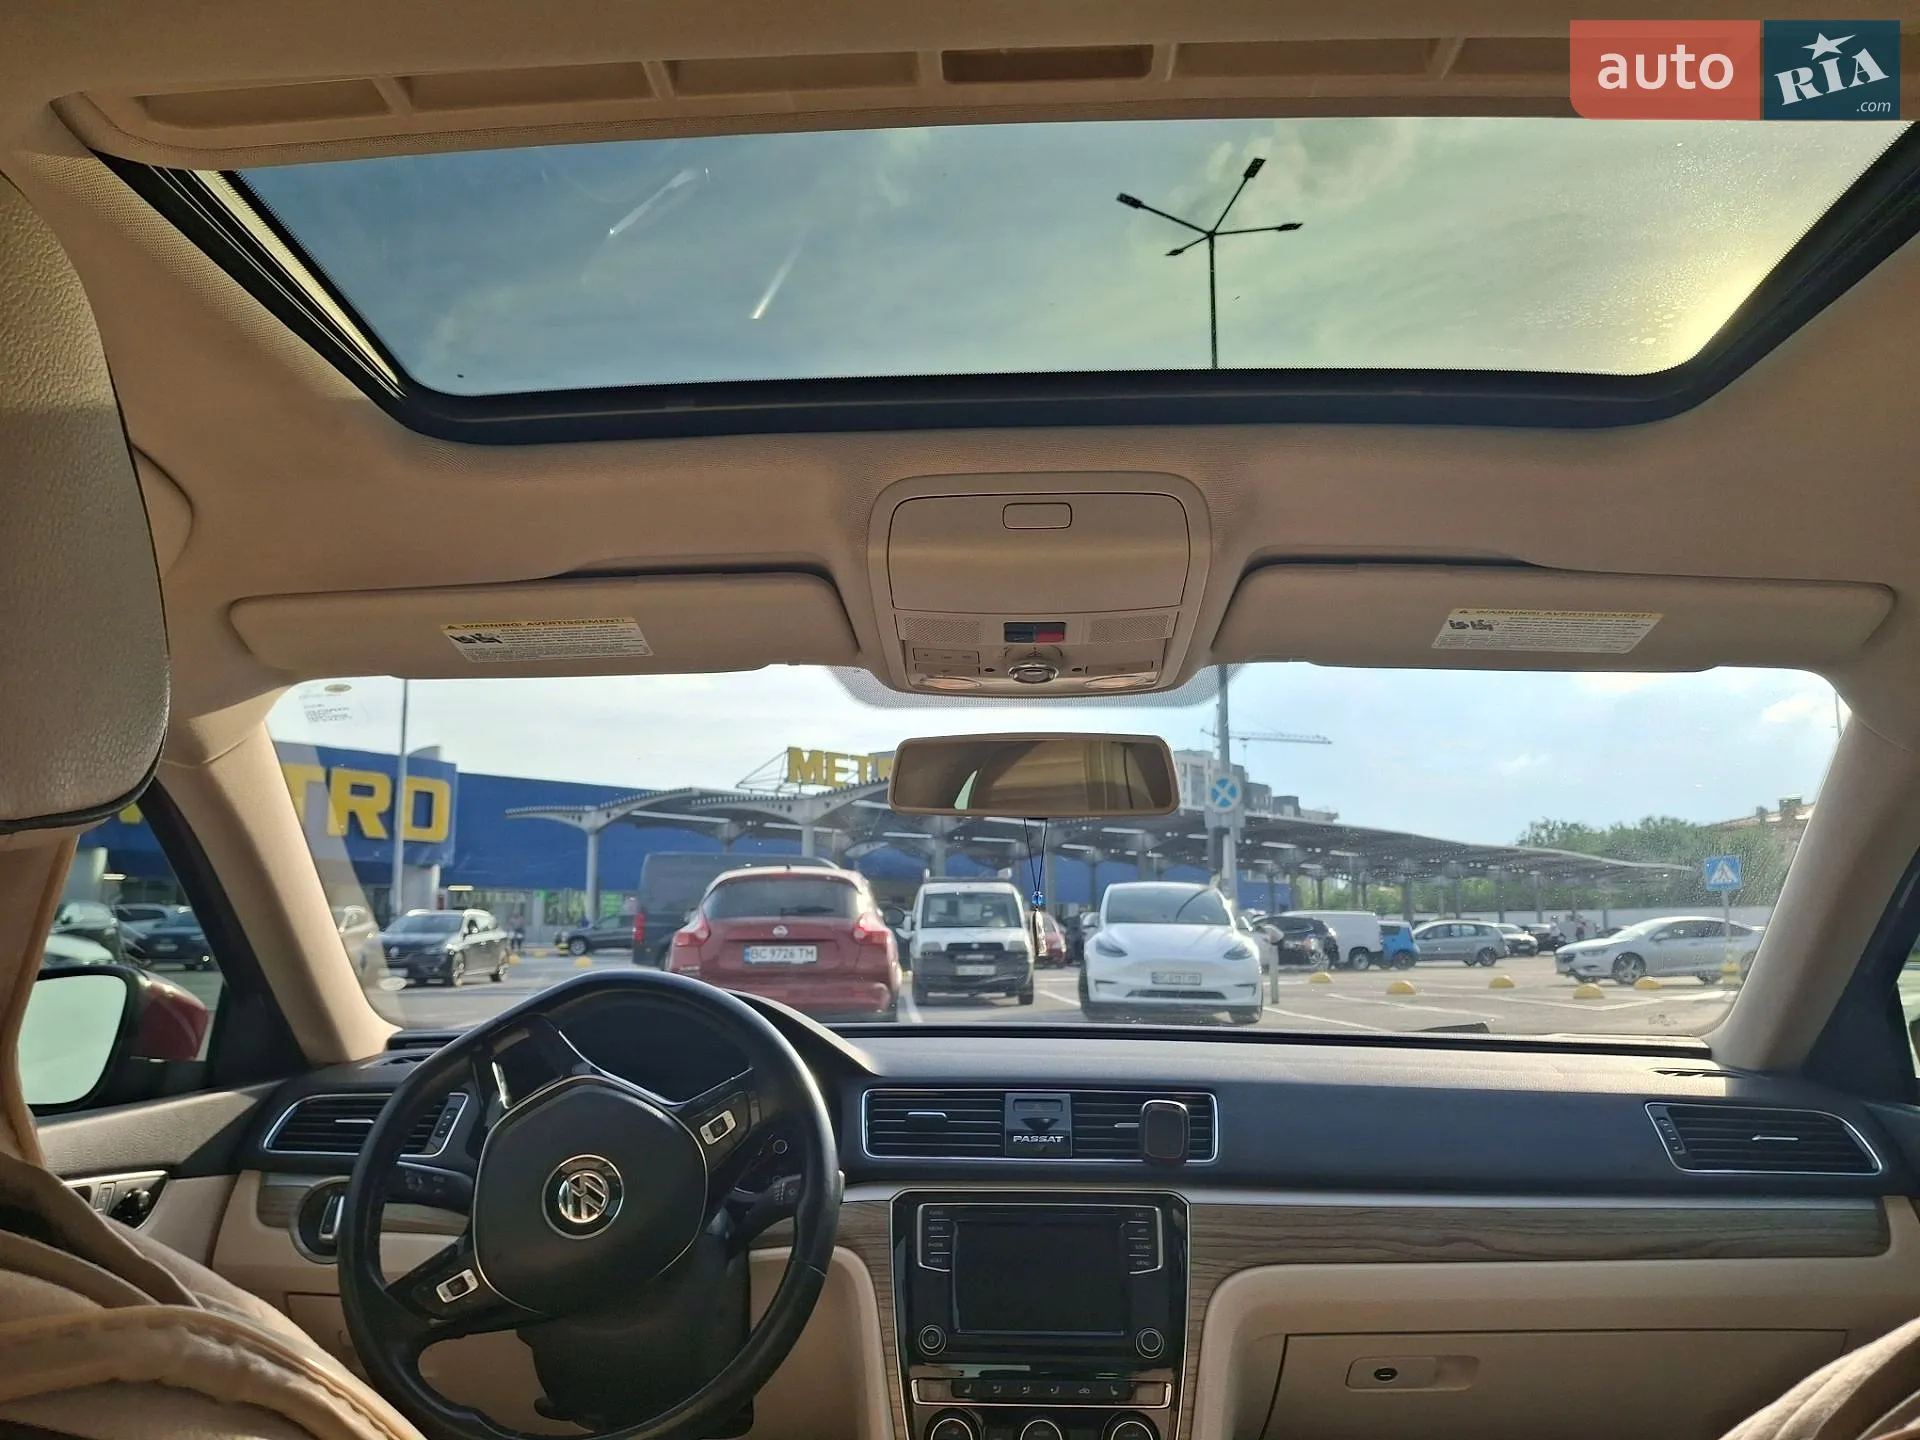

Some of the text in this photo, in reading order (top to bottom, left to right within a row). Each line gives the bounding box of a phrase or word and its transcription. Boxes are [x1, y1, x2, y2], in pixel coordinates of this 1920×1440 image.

[281, 763, 451, 843] TRO
[751, 948, 768, 960] BC
[1012, 1135, 1064, 1143] PASSAT
